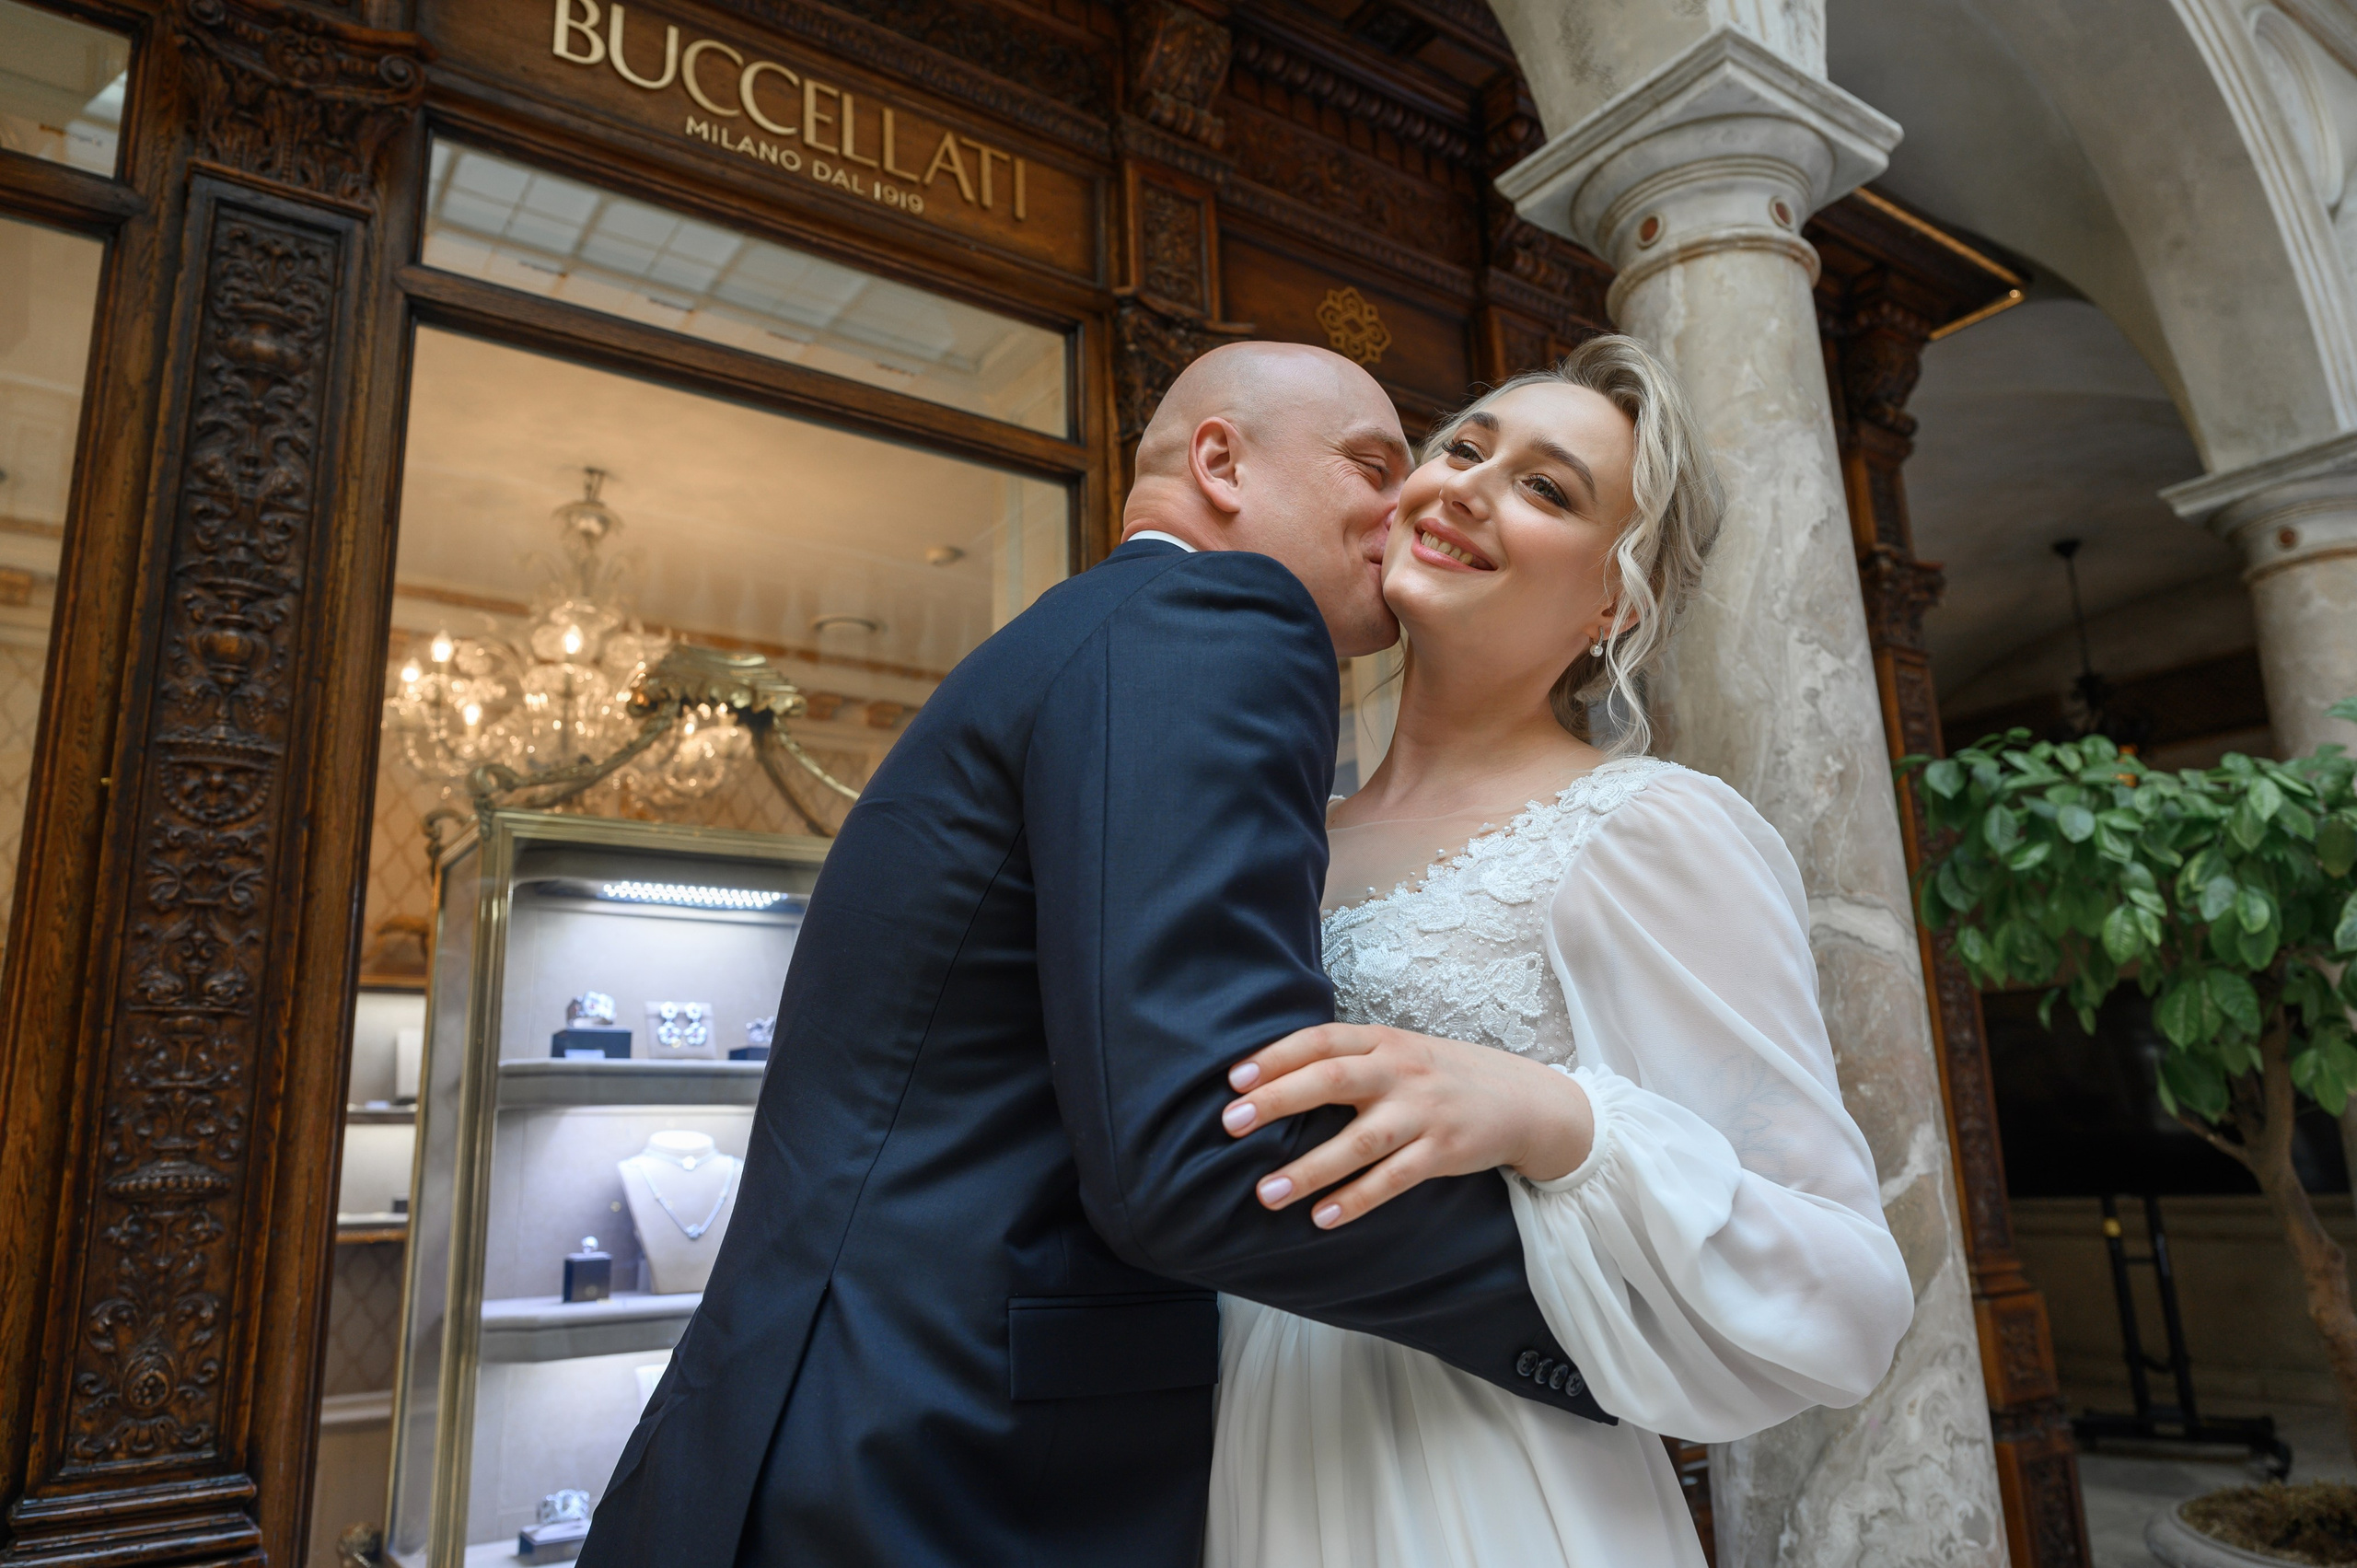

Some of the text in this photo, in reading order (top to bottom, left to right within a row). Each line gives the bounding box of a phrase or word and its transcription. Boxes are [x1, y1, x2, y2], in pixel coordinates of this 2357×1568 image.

[552, 0, 1027, 220] BUCCELLATI
[686, 116, 924, 215] MILANO DAL 1919
